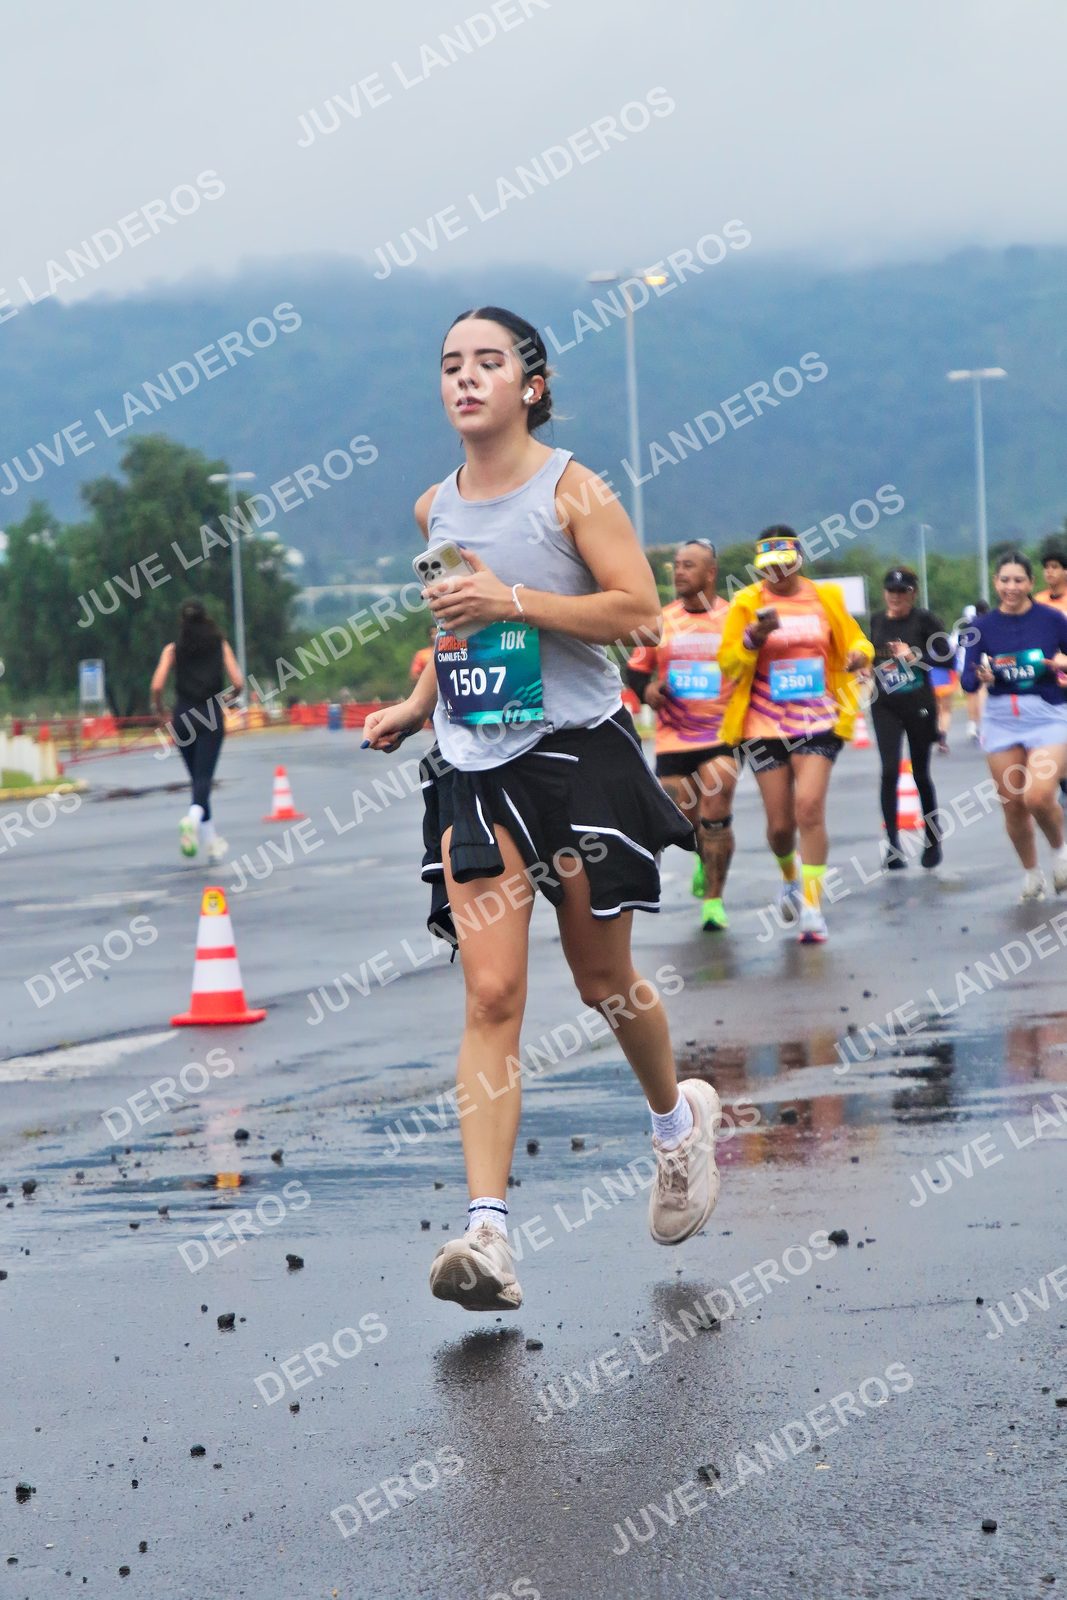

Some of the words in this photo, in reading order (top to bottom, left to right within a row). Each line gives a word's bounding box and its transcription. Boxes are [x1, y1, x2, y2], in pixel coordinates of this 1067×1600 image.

[500, 630, 527, 651] 10K
[449, 666, 507, 696] 1507
[778, 673, 813, 690] 2501
